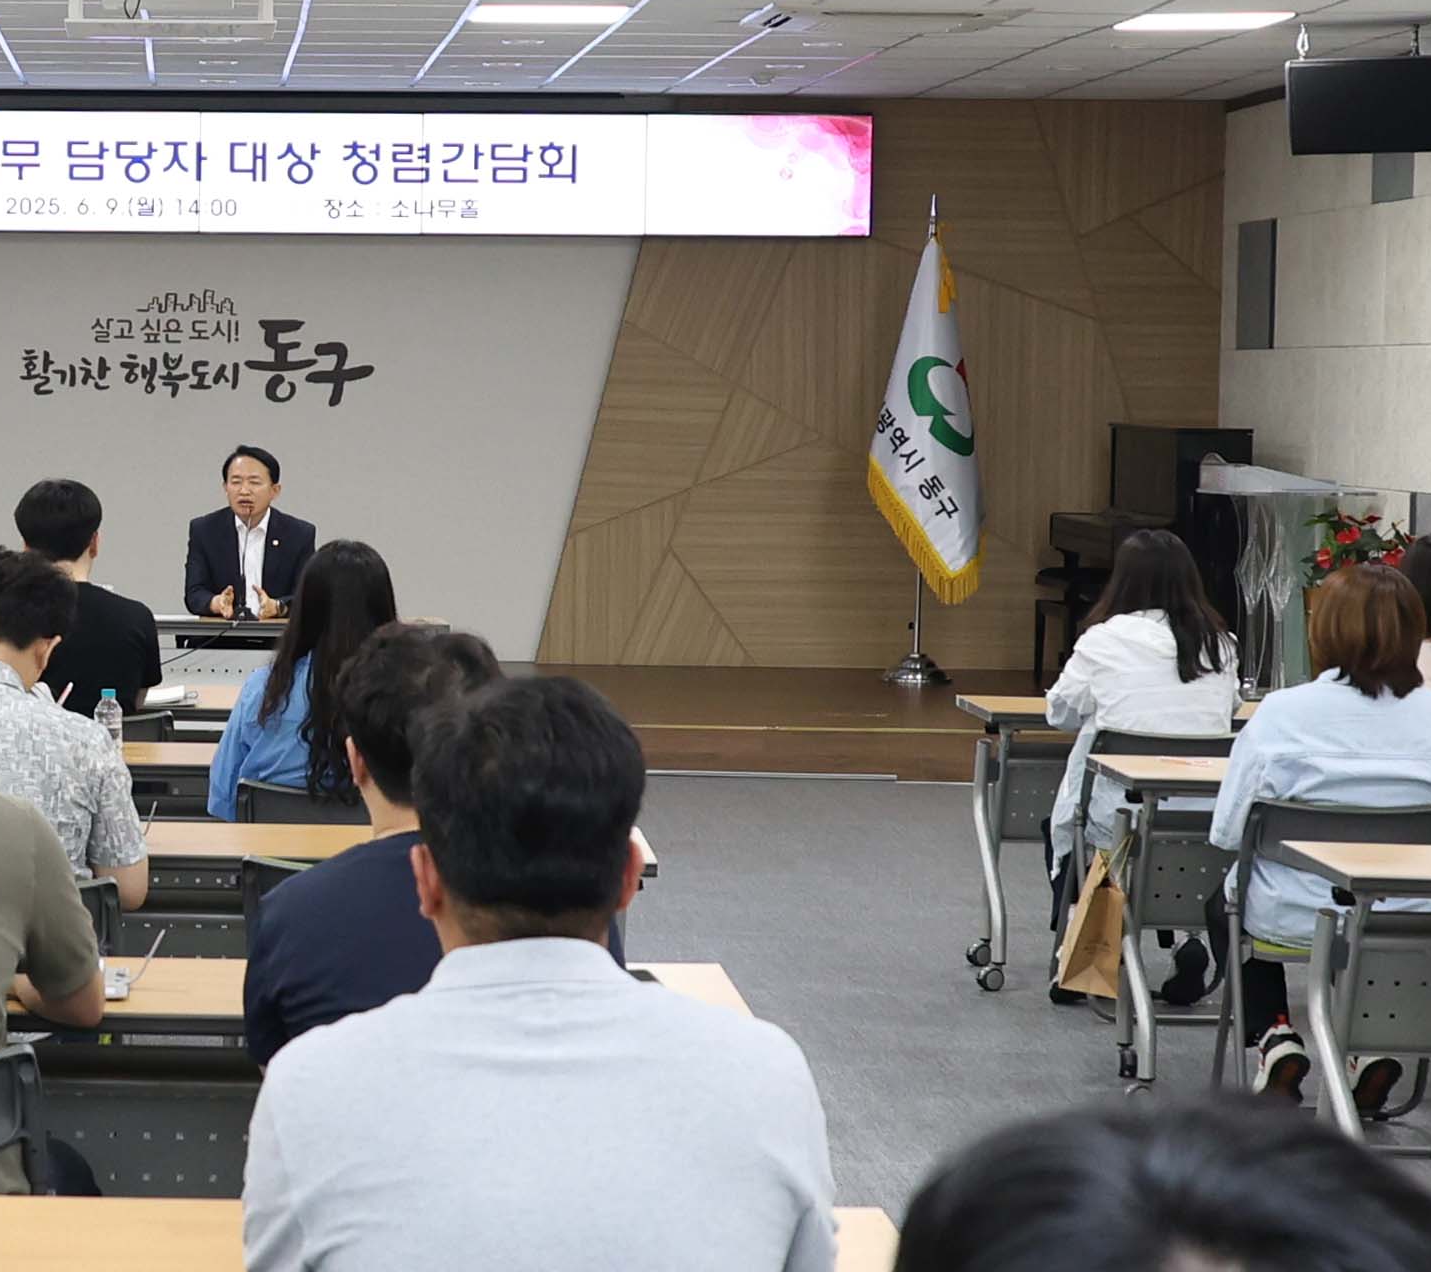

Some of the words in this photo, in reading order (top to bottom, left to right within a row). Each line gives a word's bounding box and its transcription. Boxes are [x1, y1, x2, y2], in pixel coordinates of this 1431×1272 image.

[67, 140, 208, 183] 담당자
[230, 142, 321, 185] 대상
[342, 141, 577, 185] 청렴간담회
[6, 198, 66, 215] 2025.
[177, 198, 238, 217] 14:00
[323, 199, 365, 219] 장소
[391, 199, 480, 219] 소나무홀
[91, 318, 135, 343] 살고
[140, 318, 183, 344] 싶은
[189, 319, 240, 343] 도시!
[19, 349, 111, 395] 활기찬
[120, 351, 240, 398] 행복도시
[244, 319, 375, 407] 동구
[918, 475, 960, 519] 동구
